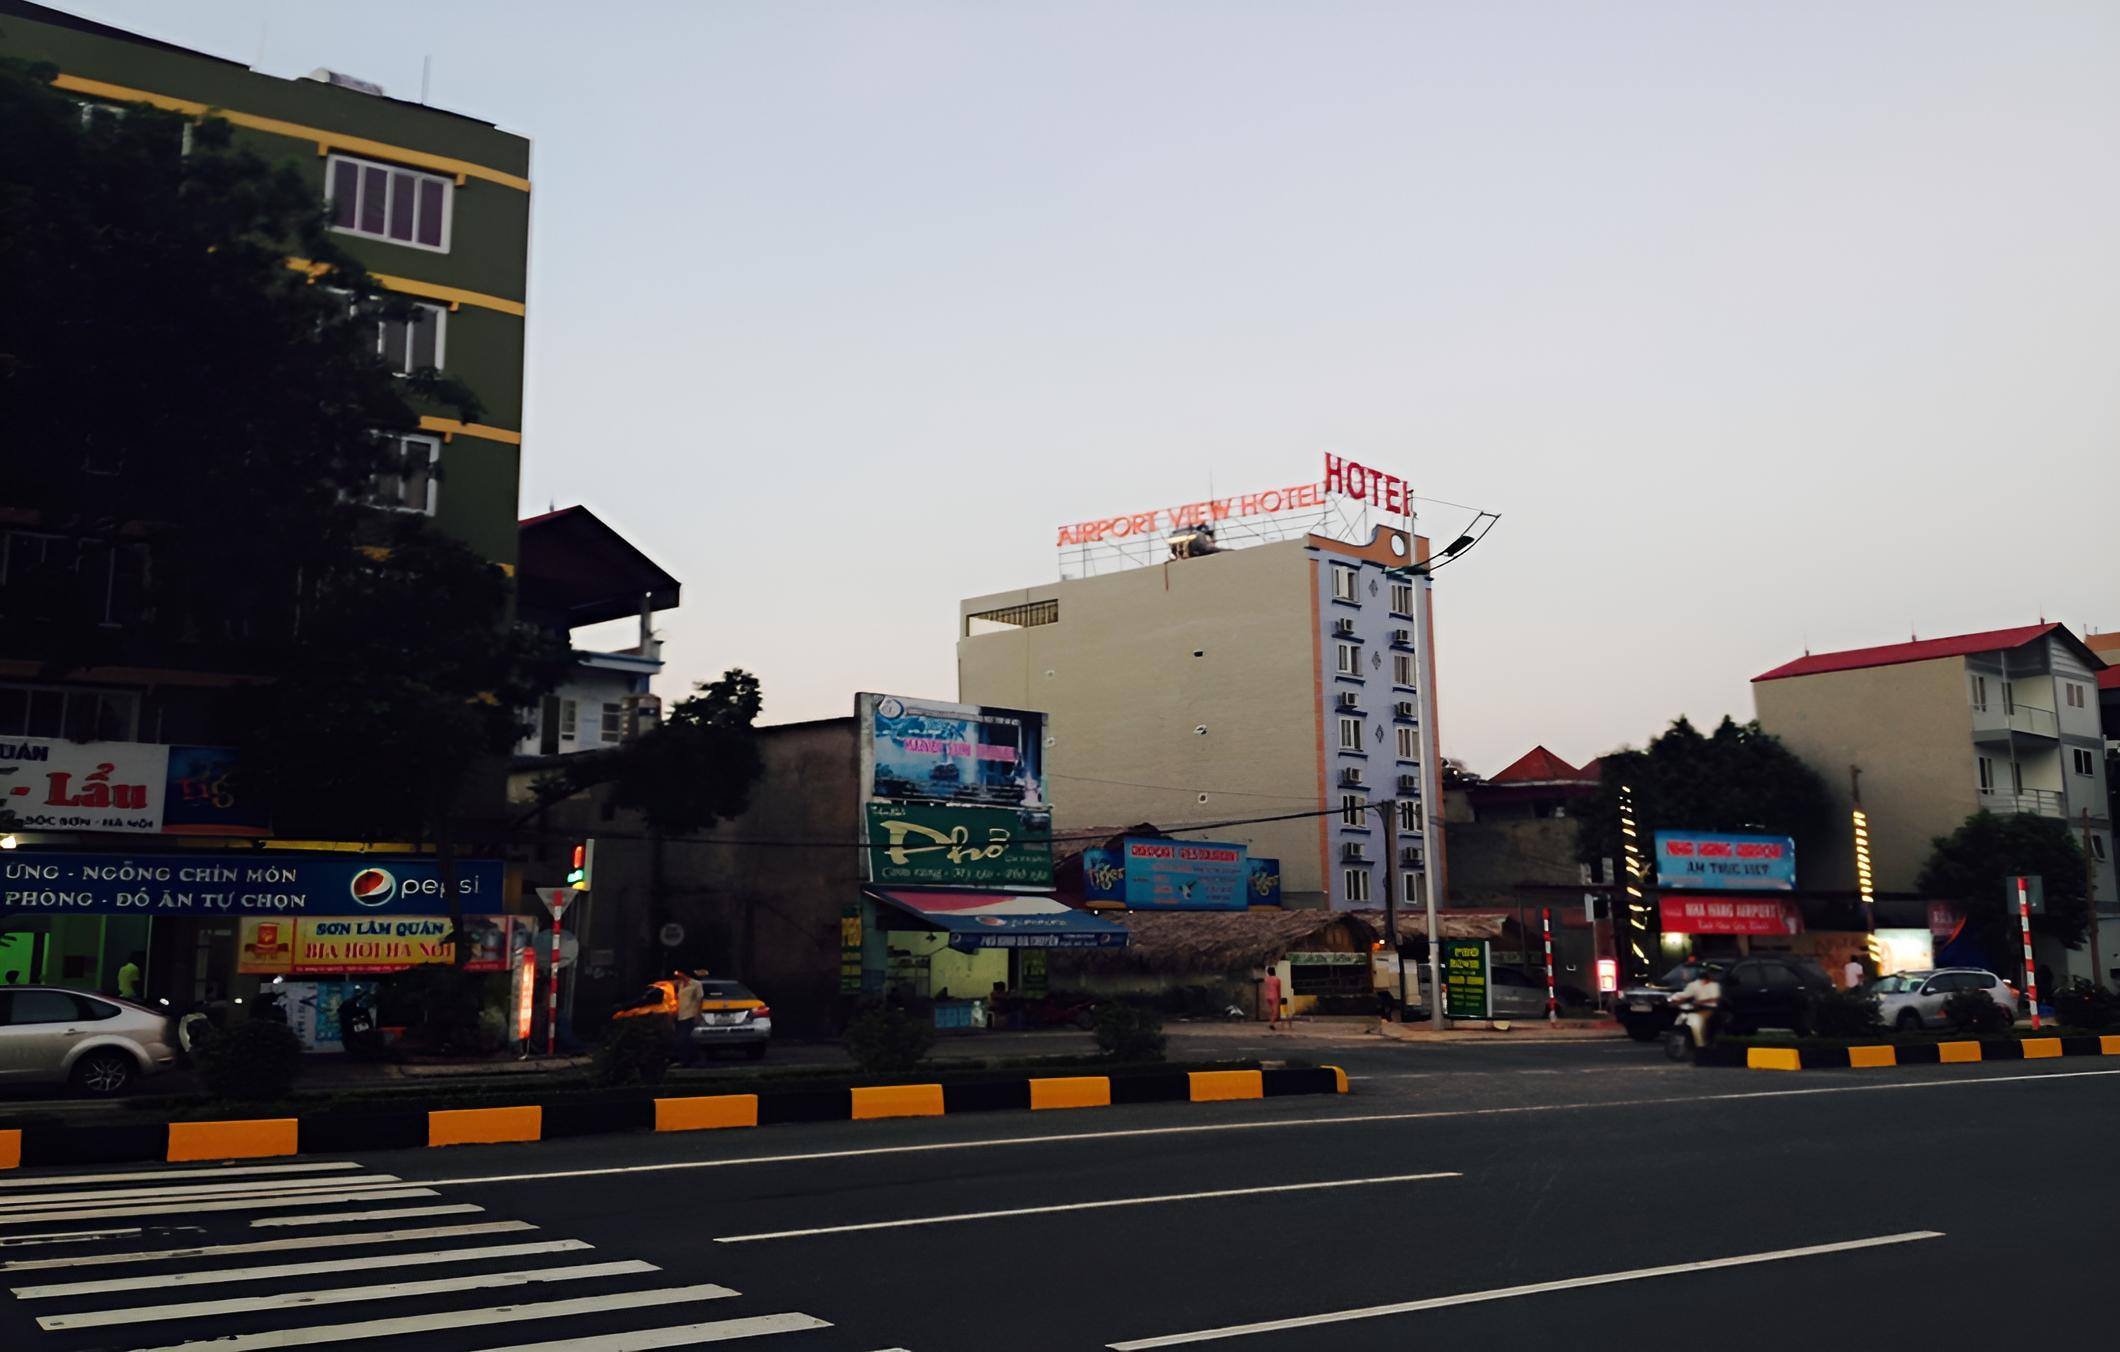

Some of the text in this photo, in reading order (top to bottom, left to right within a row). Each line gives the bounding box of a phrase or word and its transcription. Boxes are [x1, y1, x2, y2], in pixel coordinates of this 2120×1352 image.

[1325, 452, 1411, 517] HOTEL
[1056, 483, 1326, 547] AIRPORT VIEW HOTEL
[44, 762, 148, 810] Lẩu
[201, 890, 236, 912] TỰ
[240, 893, 307, 911] CHỌN
